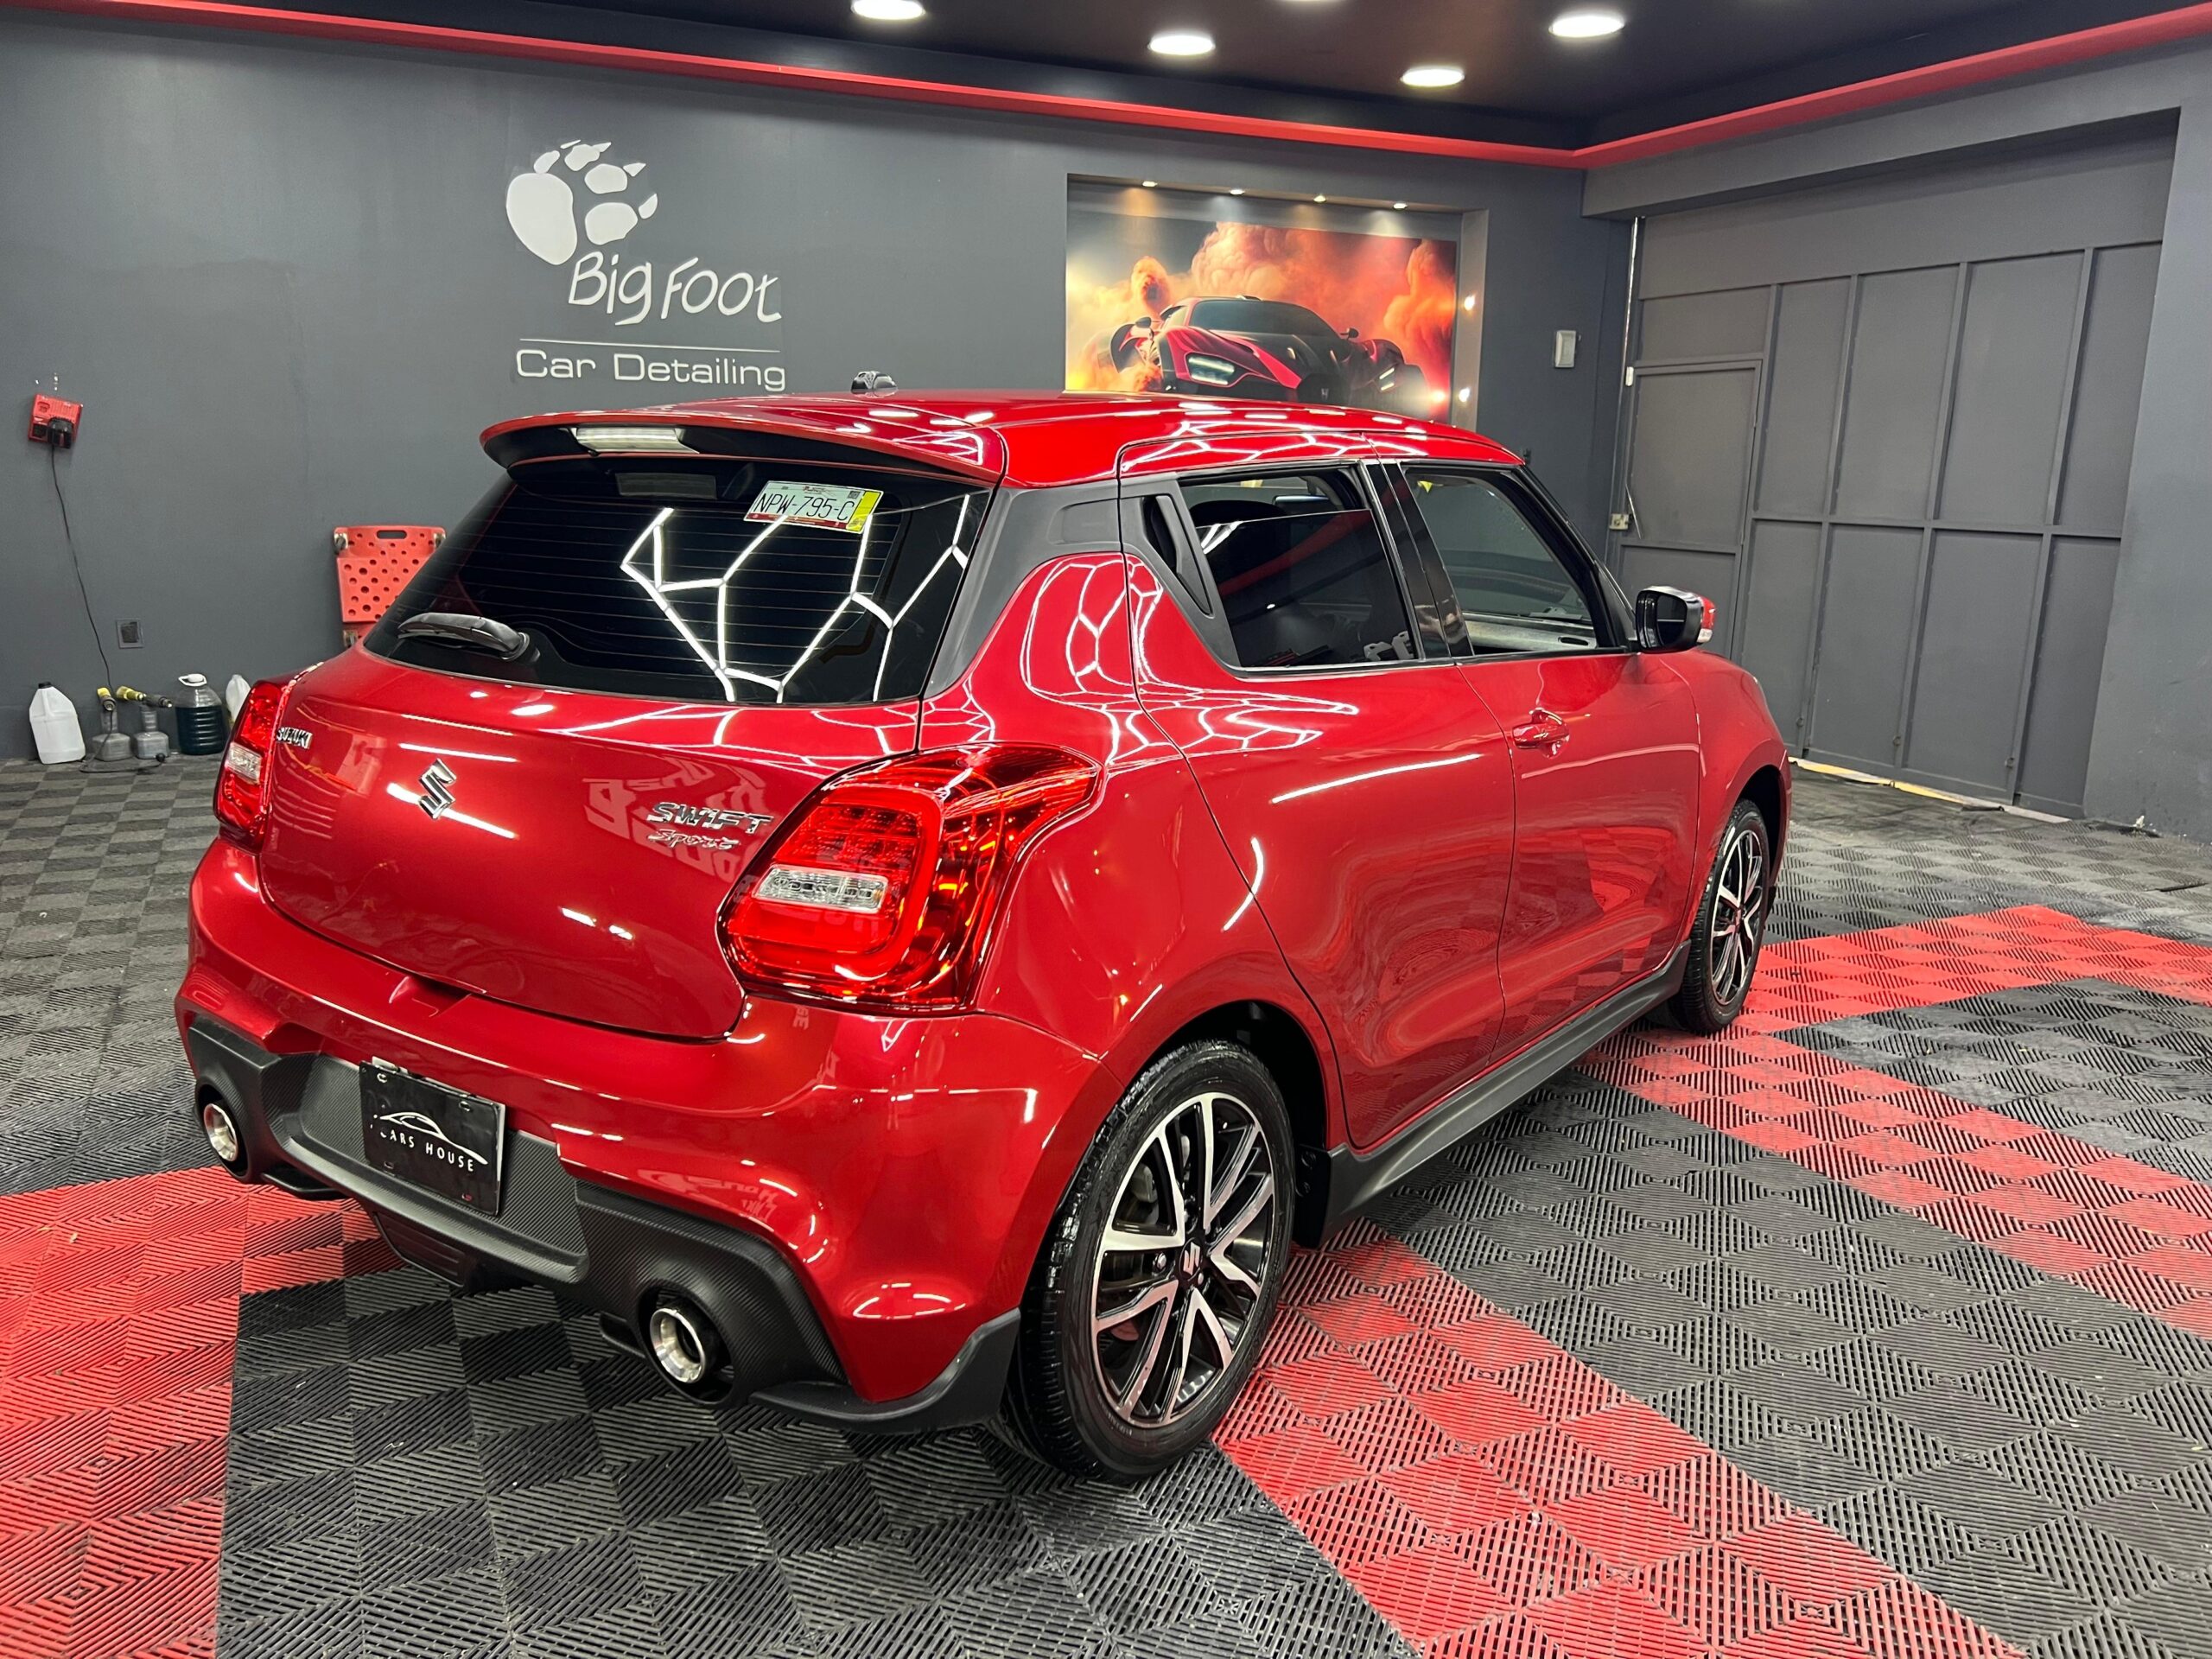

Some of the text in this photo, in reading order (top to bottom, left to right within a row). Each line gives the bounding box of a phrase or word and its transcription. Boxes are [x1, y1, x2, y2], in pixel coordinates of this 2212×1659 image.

[568, 251, 652, 327] Big
[516, 349, 785, 391] Car Detailing
[753, 493, 855, 521] NPW-795-C
[276, 727, 313, 749] SUZUKI
[646, 801, 774, 834] SWIFT
[648, 829, 741, 850] Sport
[425, 1141, 474, 1172] HOUSE
